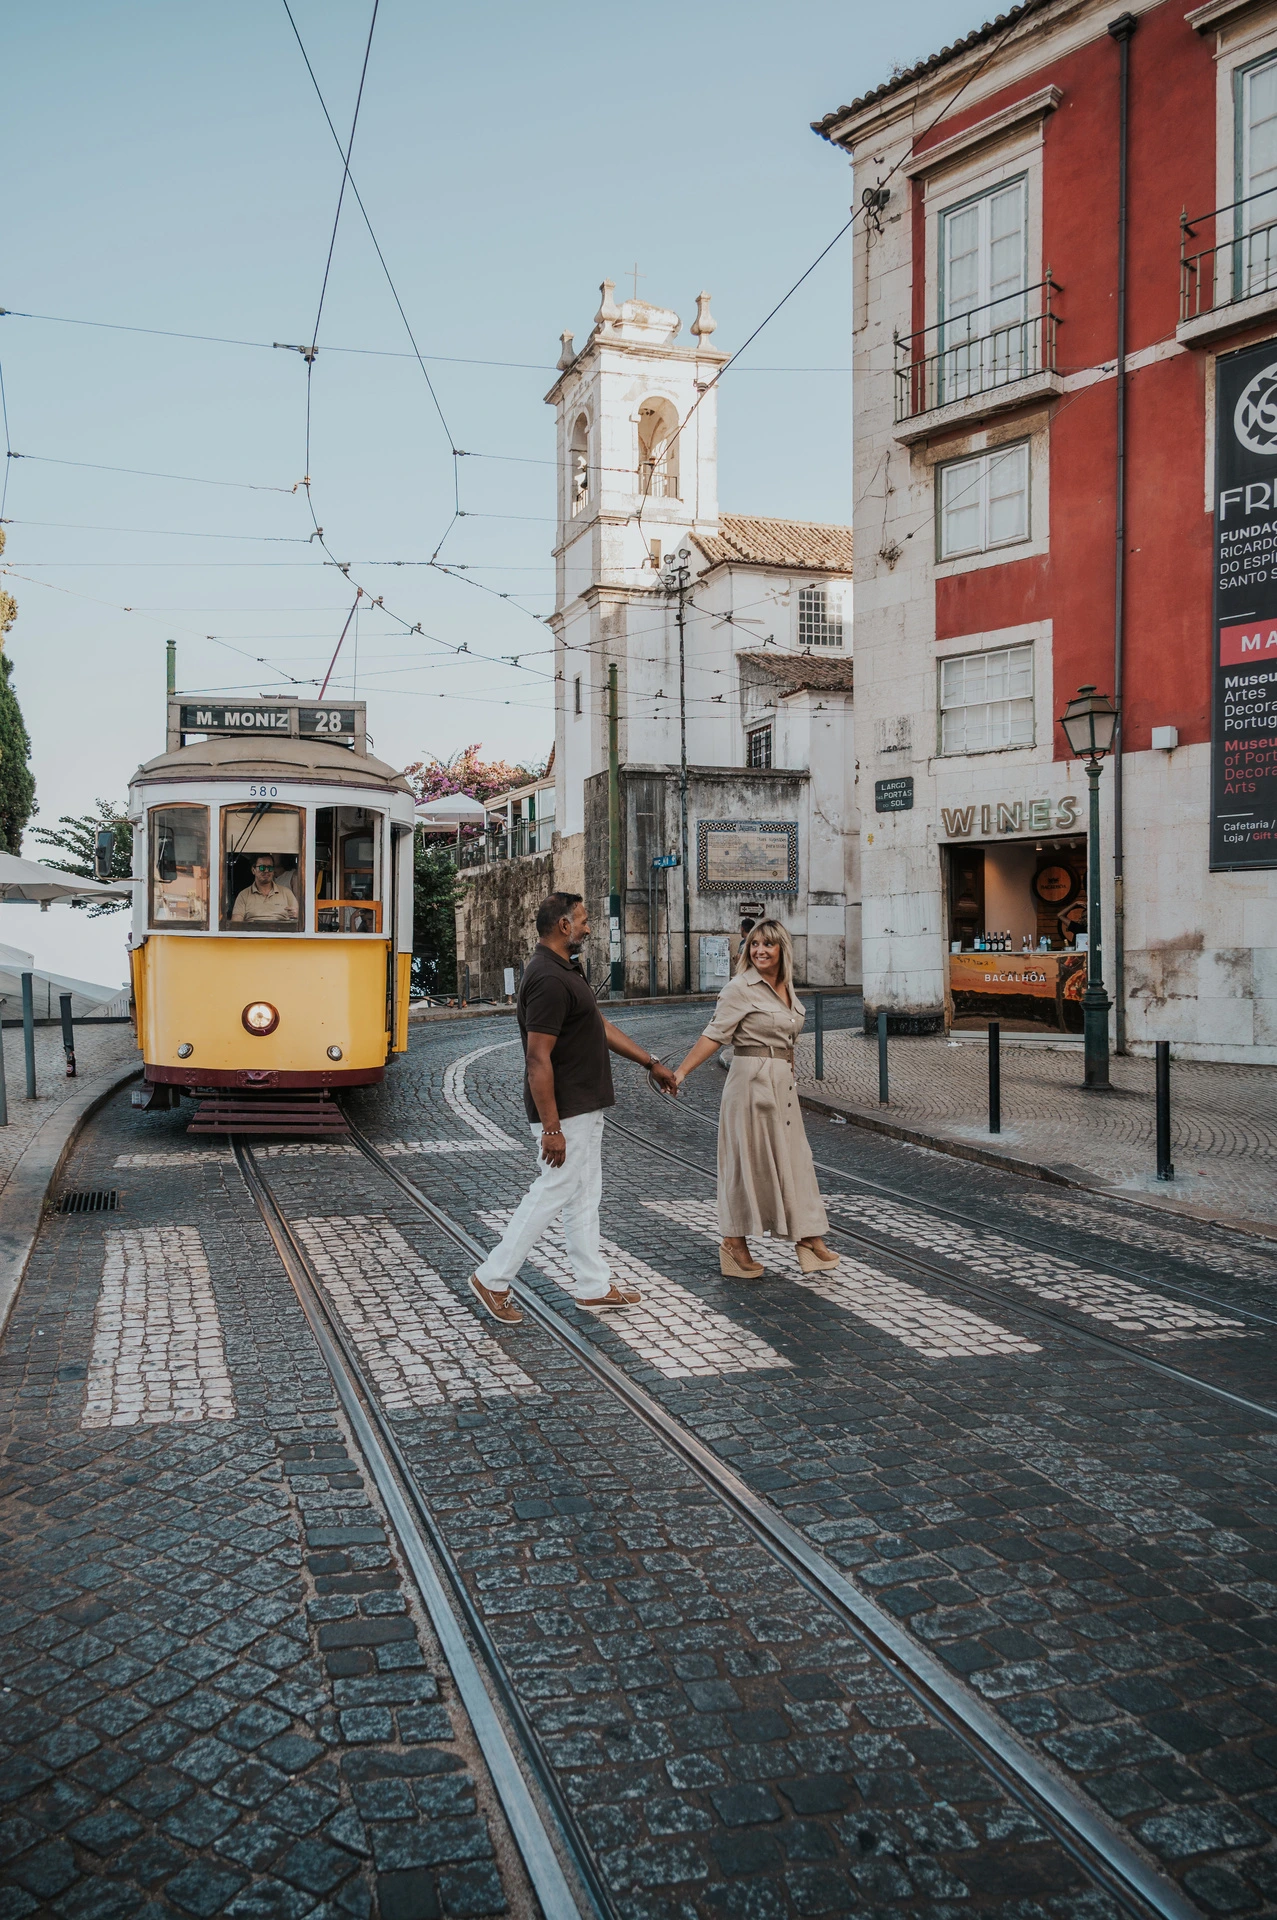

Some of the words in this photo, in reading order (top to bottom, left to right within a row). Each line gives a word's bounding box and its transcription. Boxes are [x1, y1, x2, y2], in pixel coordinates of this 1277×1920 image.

[1220, 560, 1240, 575] DO
[1244, 550, 1277, 570] ESPÍ
[1219, 570, 1267, 590] SANTO
[1224, 672, 1277, 689] Museu
[1224, 688, 1266, 703] Artes
[196, 711, 218, 725] M.
[224, 712, 289, 728] MONIZ
[315, 711, 342, 733] 28
[1224, 715, 1277, 732] Portug
[1224, 737, 1277, 753] Museu
[1224, 752, 1241, 766] of
[250, 785, 278, 797] 580
[881, 781, 906, 791] LARGO
[1224, 782, 1256, 795] Arts
[883, 789, 912, 799] PORTAS
[890, 799, 905, 807] SOL
[941, 795, 1077, 837] WINES
[1223, 820, 1269, 831] Cafetaria
[1223, 833, 1244, 844] Loja
[1252, 831, 1272, 841] Gift
[984, 971, 1046, 983] BACALHÔA
